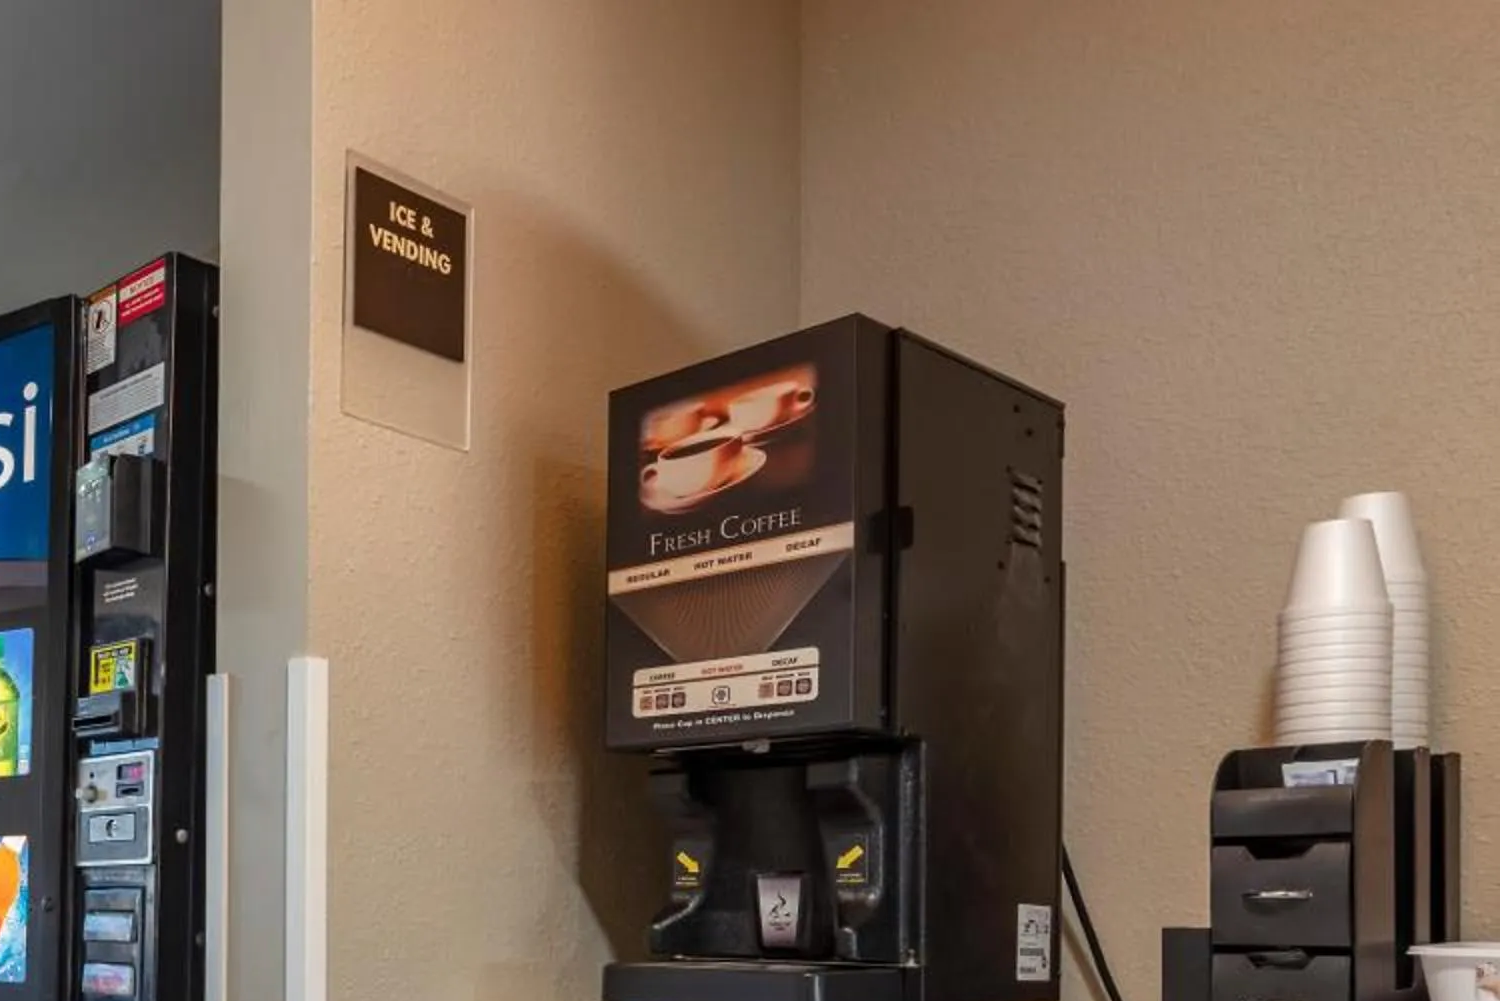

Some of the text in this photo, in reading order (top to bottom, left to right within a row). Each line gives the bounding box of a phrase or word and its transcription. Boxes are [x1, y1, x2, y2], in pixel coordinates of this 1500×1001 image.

[389, 201, 434, 238] ICE &
[369, 223, 452, 275] VENDING
[650, 509, 801, 556] FRESH COFFEE
[626, 538, 822, 583] REGULAR HOT WATER DECAF
[771, 657, 799, 667] DECAF
[705, 713, 740, 725] CENTER
